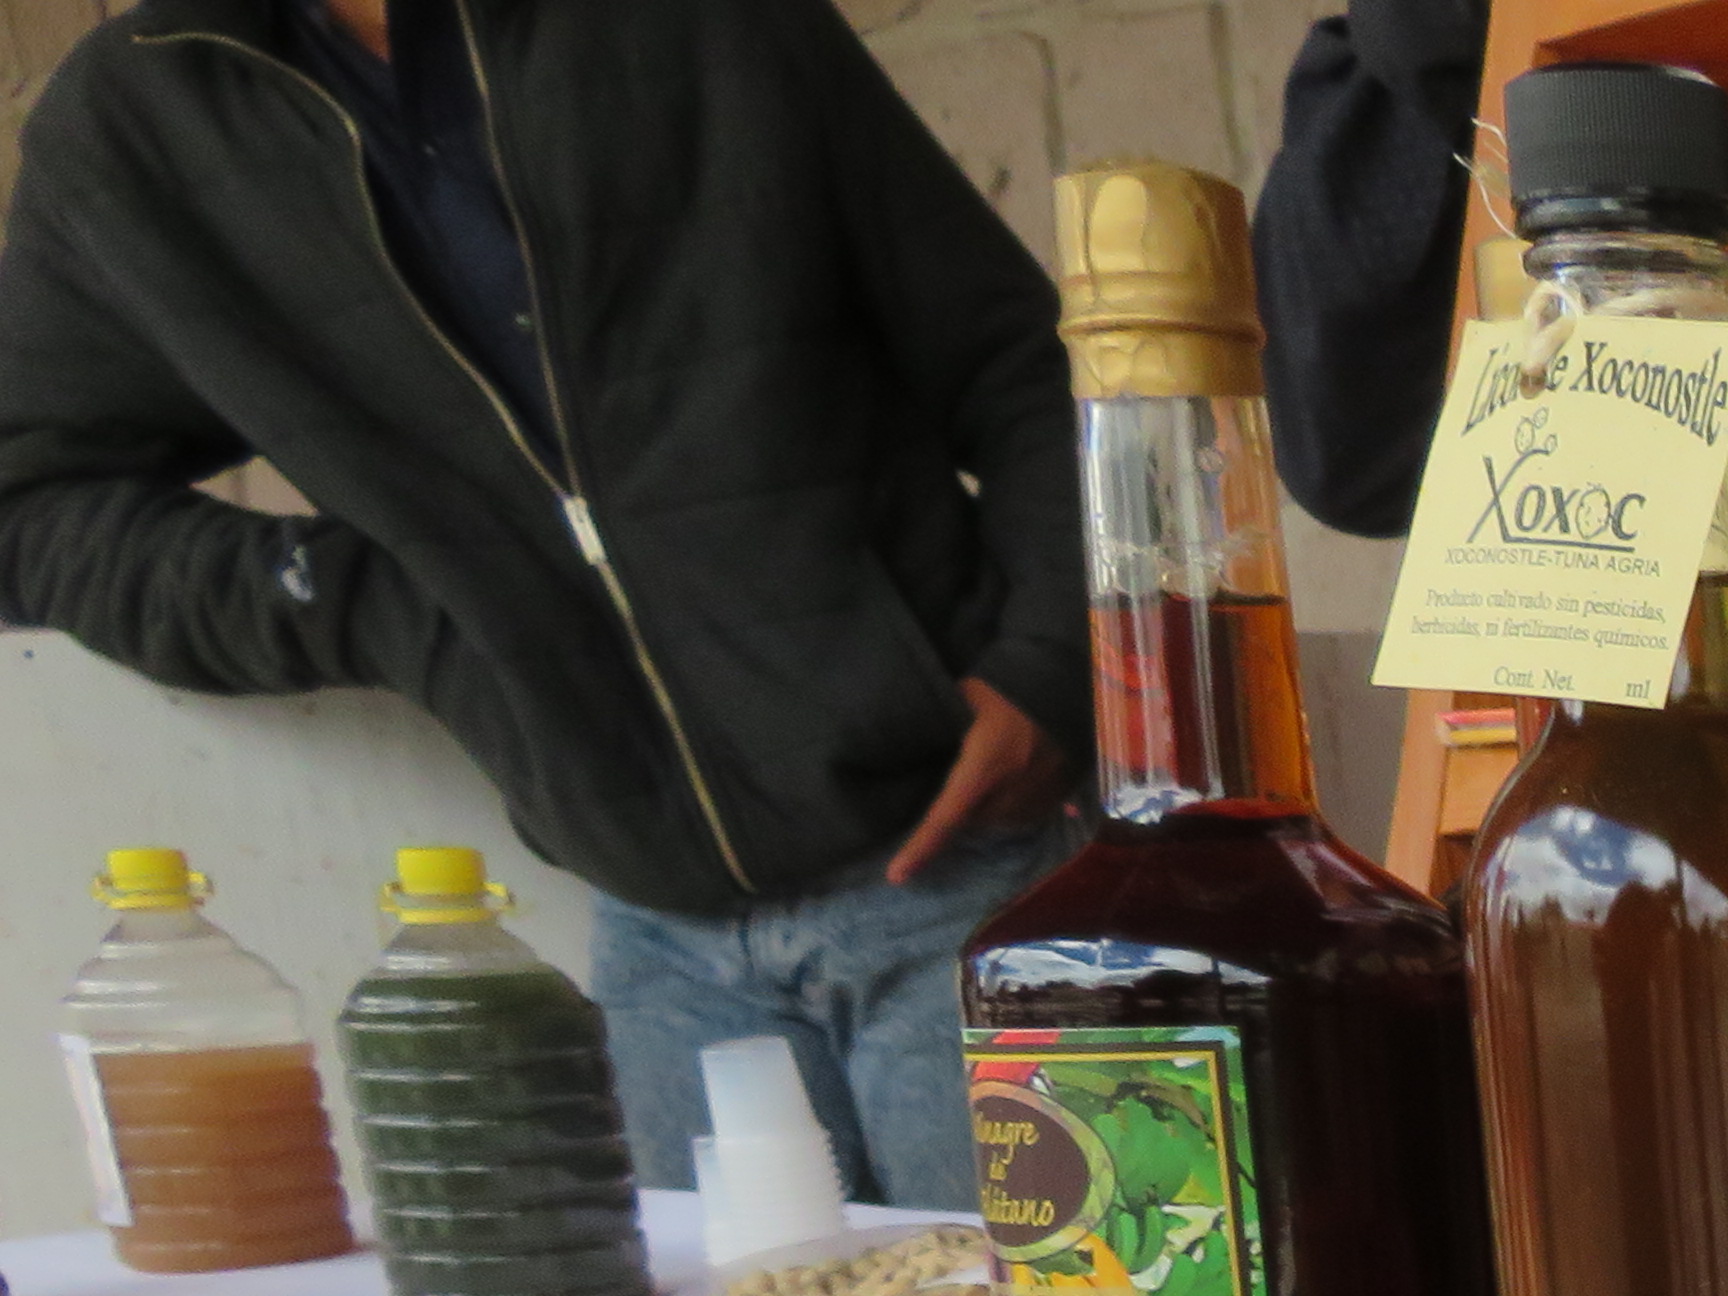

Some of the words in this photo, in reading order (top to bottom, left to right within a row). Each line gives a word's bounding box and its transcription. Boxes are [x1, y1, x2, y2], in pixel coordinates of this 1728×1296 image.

[1461, 343, 1521, 436] Lico
[1569, 340, 1728, 446] Xoconostle
[1466, 448, 1647, 552] Xoxoc
[1445, 547, 1600, 571] XOCONOSTLE-TUNA
[1605, 556, 1661, 578] AGRIA
[1426, 588, 1484, 608] Producto
[1487, 588, 1552, 611] cultivado
[1556, 592, 1580, 613] sin
[1583, 598, 1667, 625] pesticidas,
[1502, 618, 1590, 643] fertilizantes
[1494, 665, 1535, 689] Cont.
[1625, 679, 1652, 700] ml
